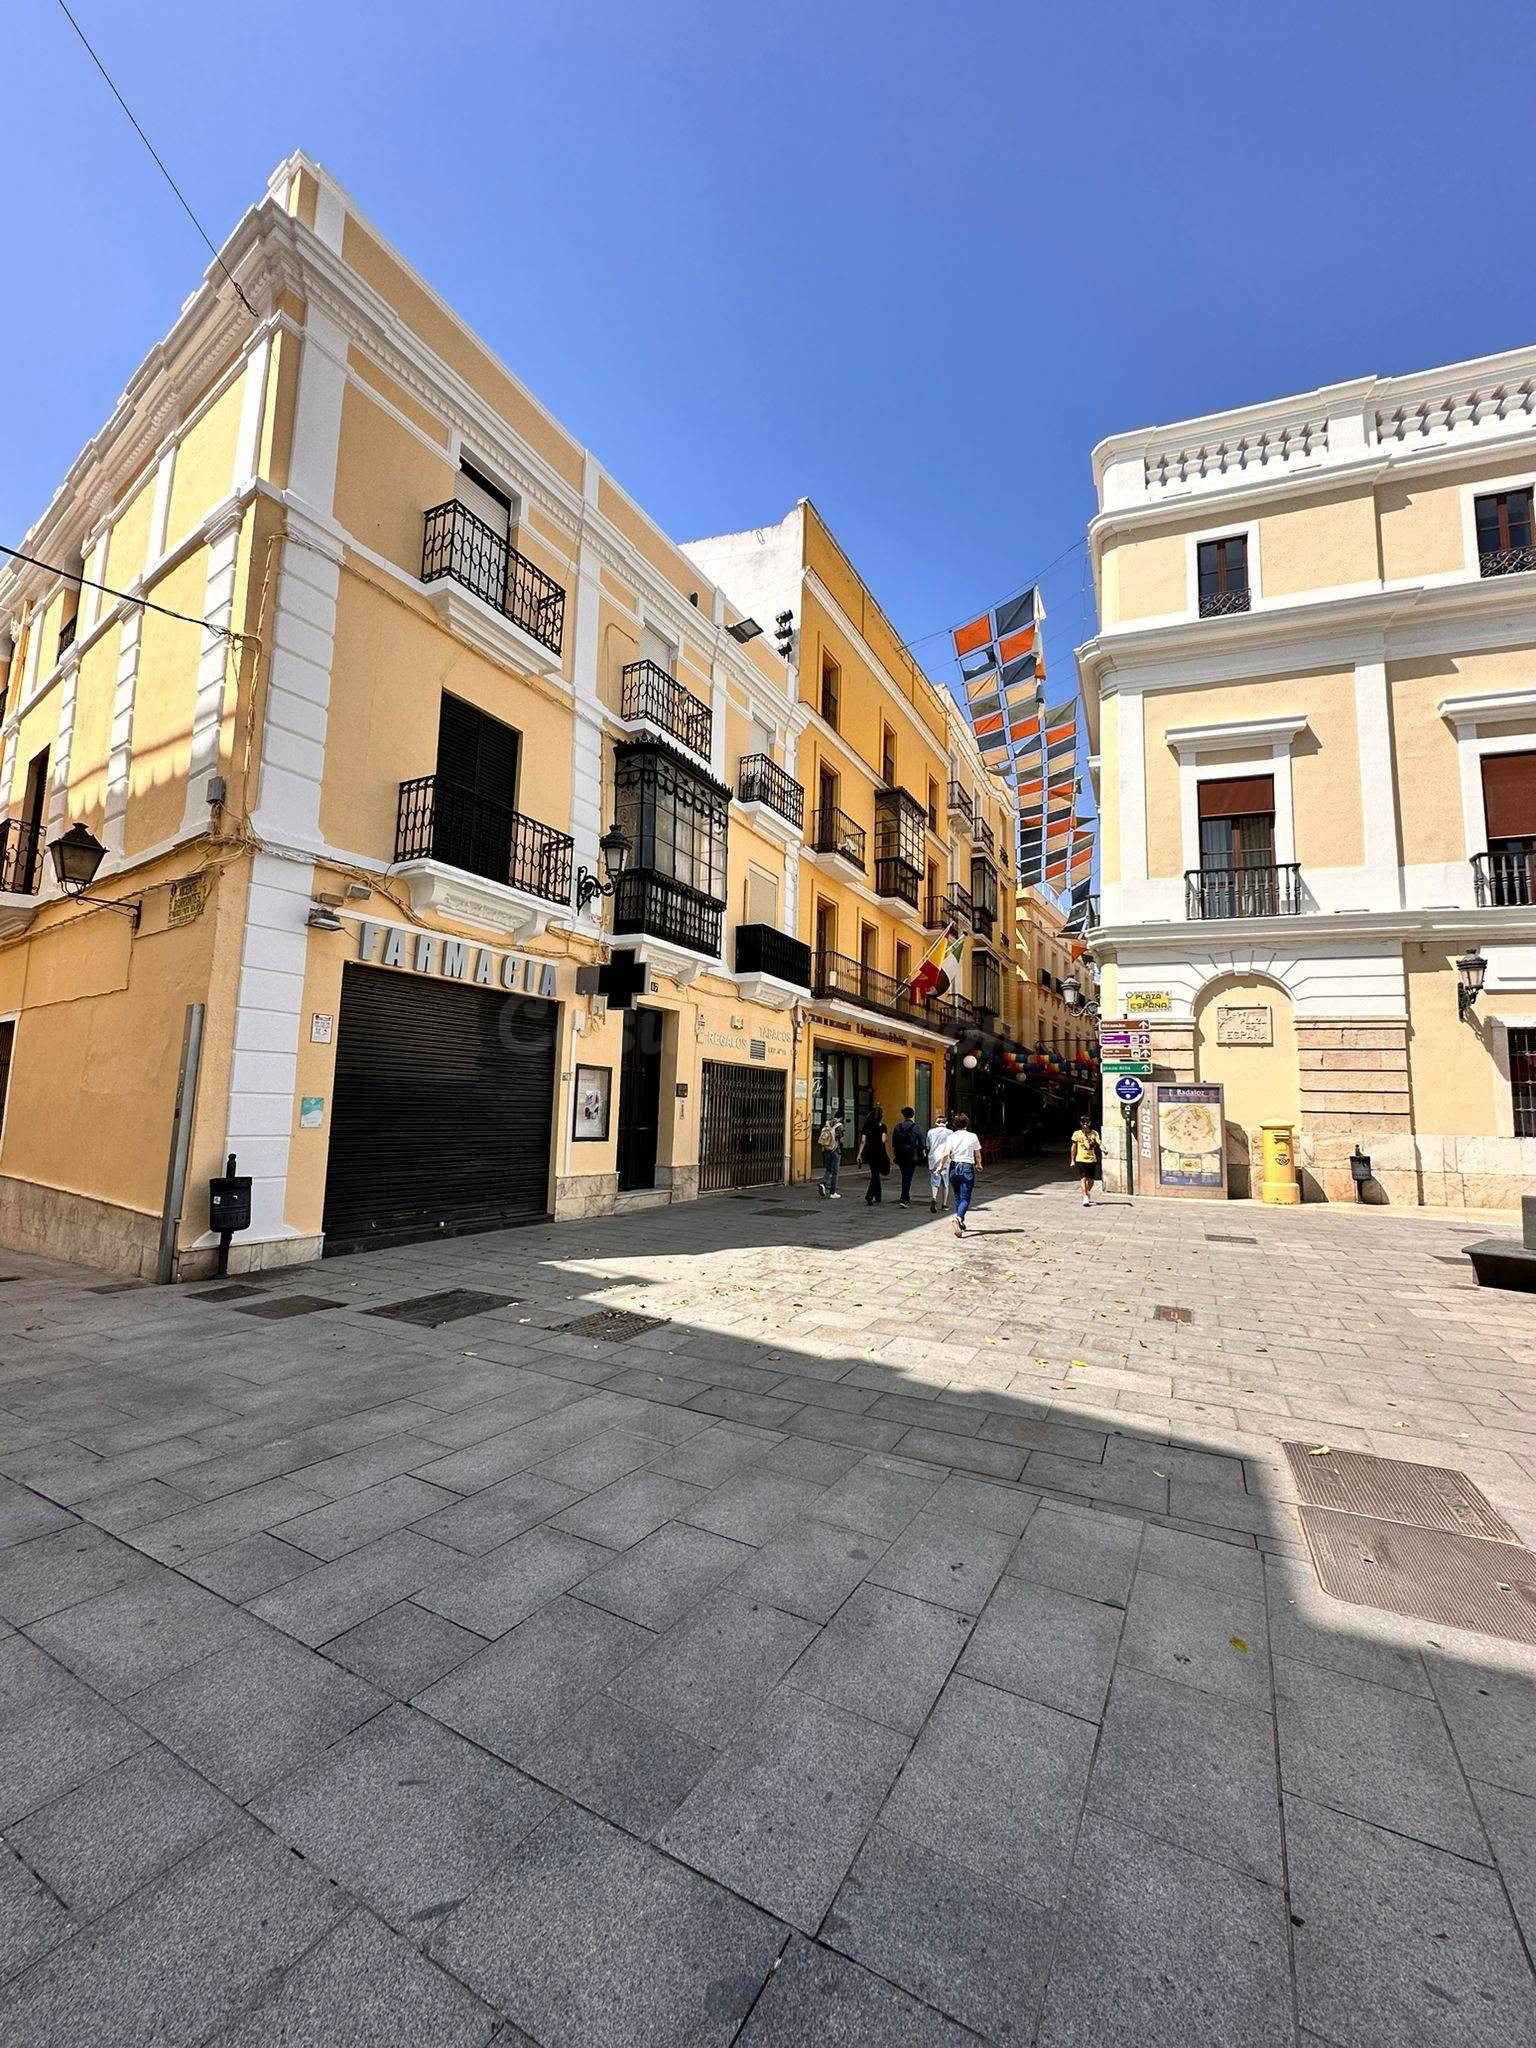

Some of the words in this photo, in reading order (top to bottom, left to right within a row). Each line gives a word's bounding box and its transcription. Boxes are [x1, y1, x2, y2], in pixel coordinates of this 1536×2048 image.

[360, 922, 558, 997] FARMACIA
[707, 1031, 748, 1049] REGALOS
[759, 1026, 792, 1042] TABACOS
[1176, 1088, 1205, 1097] Badajoz
[1141, 1107, 1154, 1159] Badajoz
